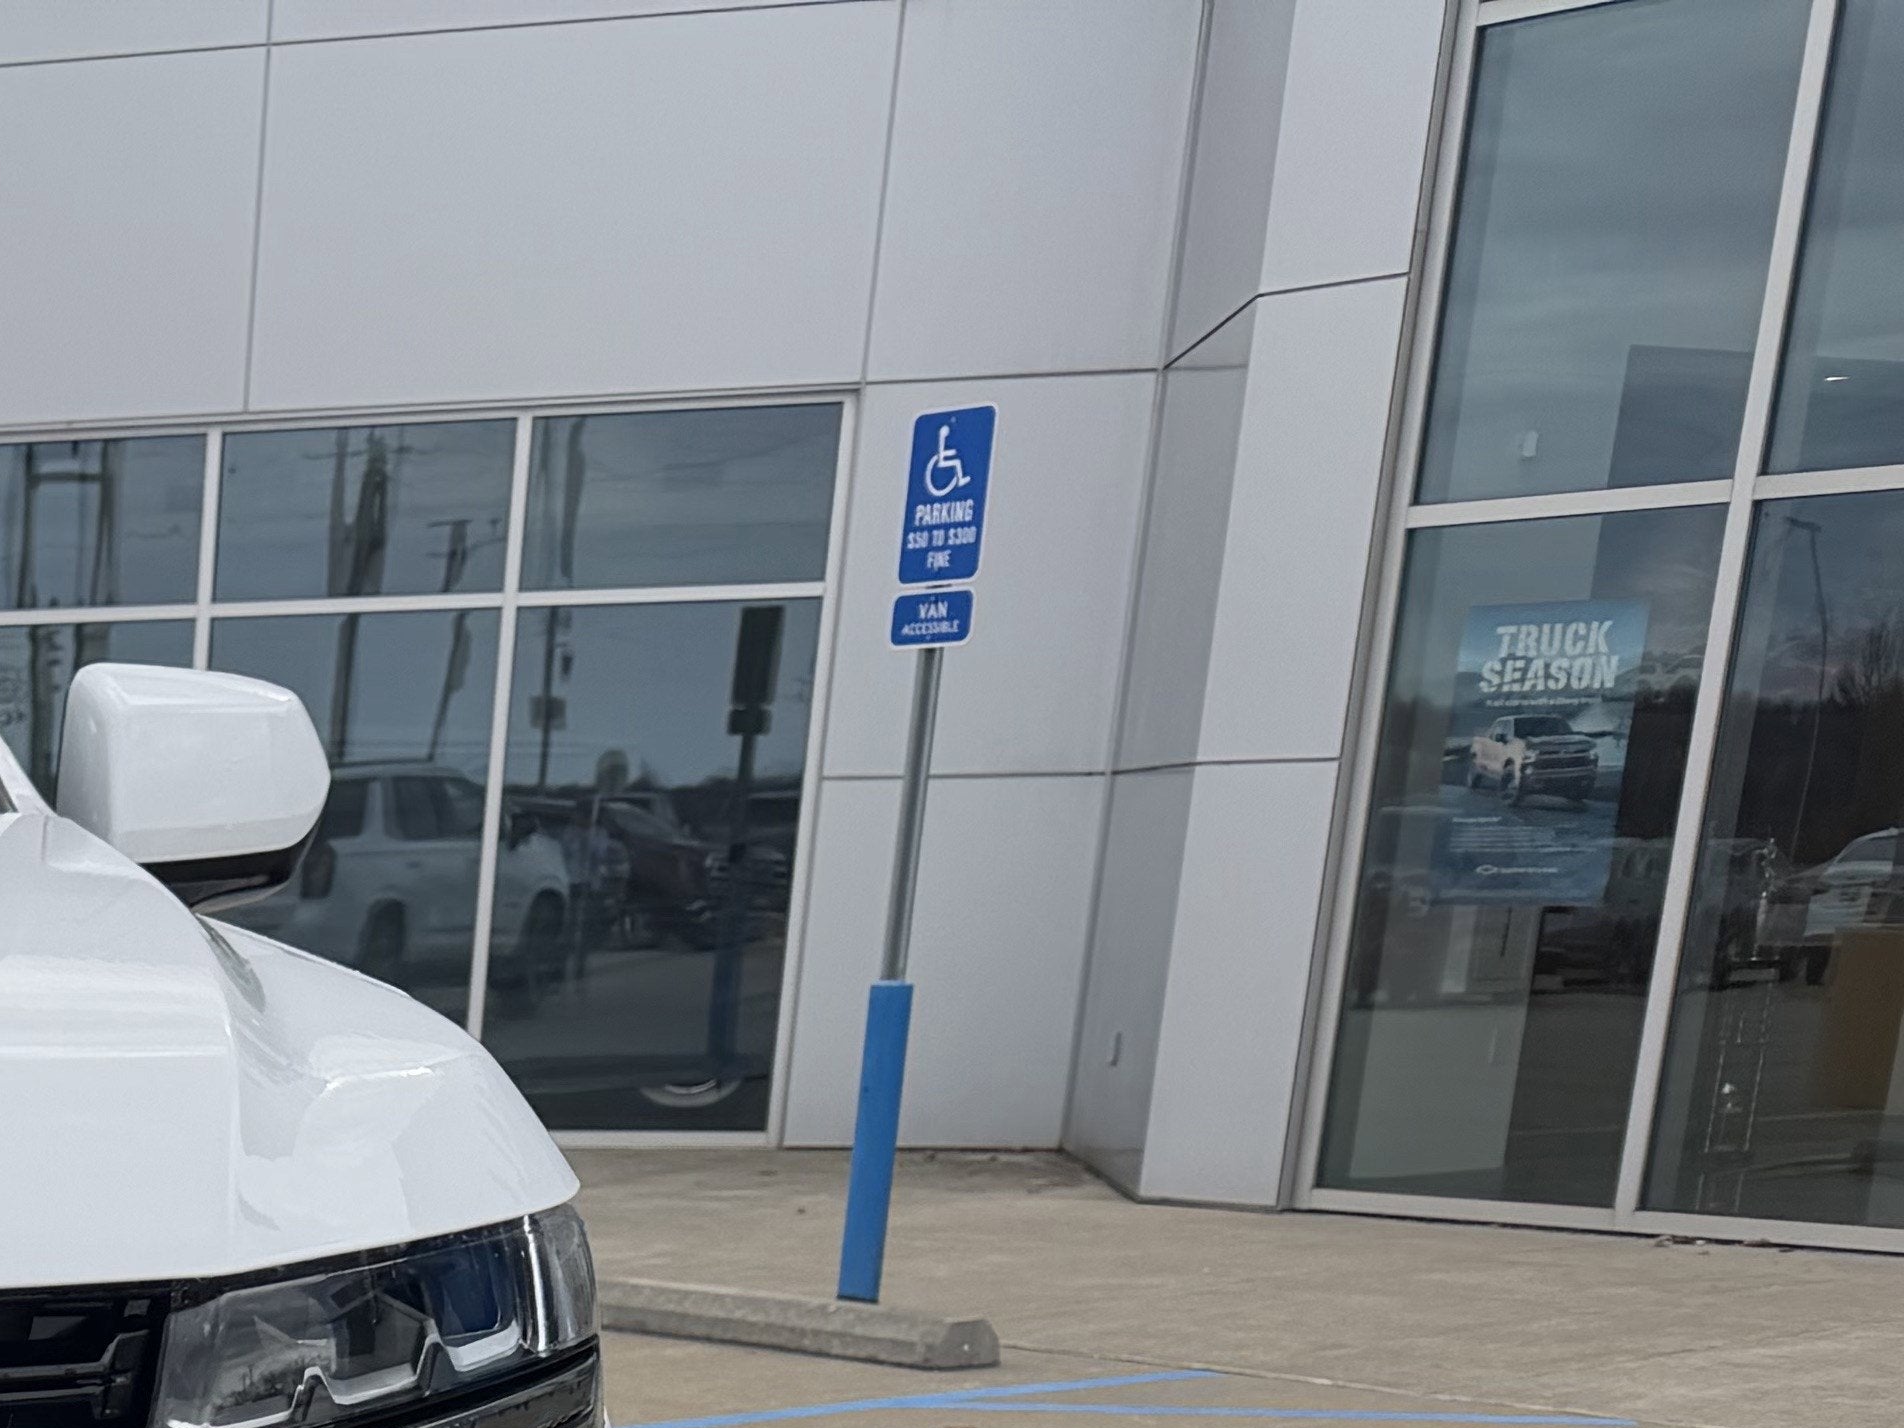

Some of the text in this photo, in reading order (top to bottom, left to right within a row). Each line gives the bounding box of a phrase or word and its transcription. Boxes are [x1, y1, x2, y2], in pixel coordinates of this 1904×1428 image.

[914, 499, 974, 526] PARKING
[907, 527, 977, 549] $50 TO $300
[927, 550, 951, 569] FINE
[918, 601, 948, 619] VAN
[901, 620, 959, 636] ACCESSIBLE
[1496, 620, 1614, 658] TRUCK
[1479, 655, 1620, 692] SEASON
